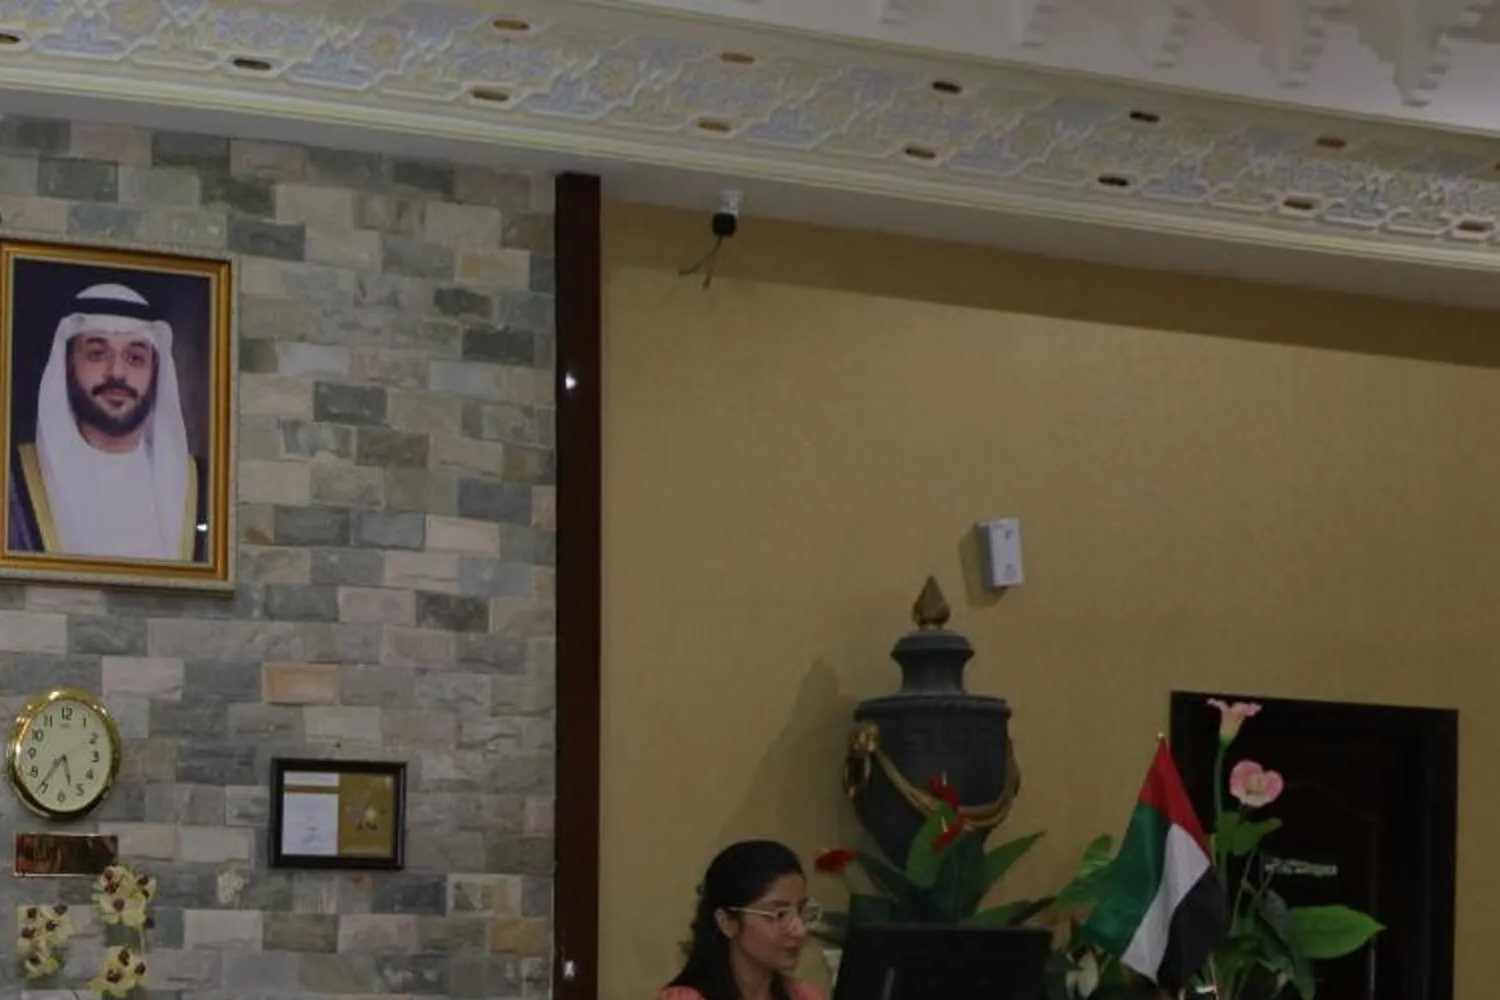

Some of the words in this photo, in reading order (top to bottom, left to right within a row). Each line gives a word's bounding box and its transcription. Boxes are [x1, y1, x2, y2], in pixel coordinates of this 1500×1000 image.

[61, 707, 73, 720] 12
[43, 715, 53, 728] 11
[32, 728, 44, 742] 10
[89, 732, 99, 745] 2
[27, 747, 37, 759] 9
[92, 751, 99, 763] 3
[30, 765, 38, 778] 8
[85, 768, 94, 781] 4
[39, 780, 48, 794] 7
[76, 782, 85, 797] 5
[57, 789, 66, 803] 6
